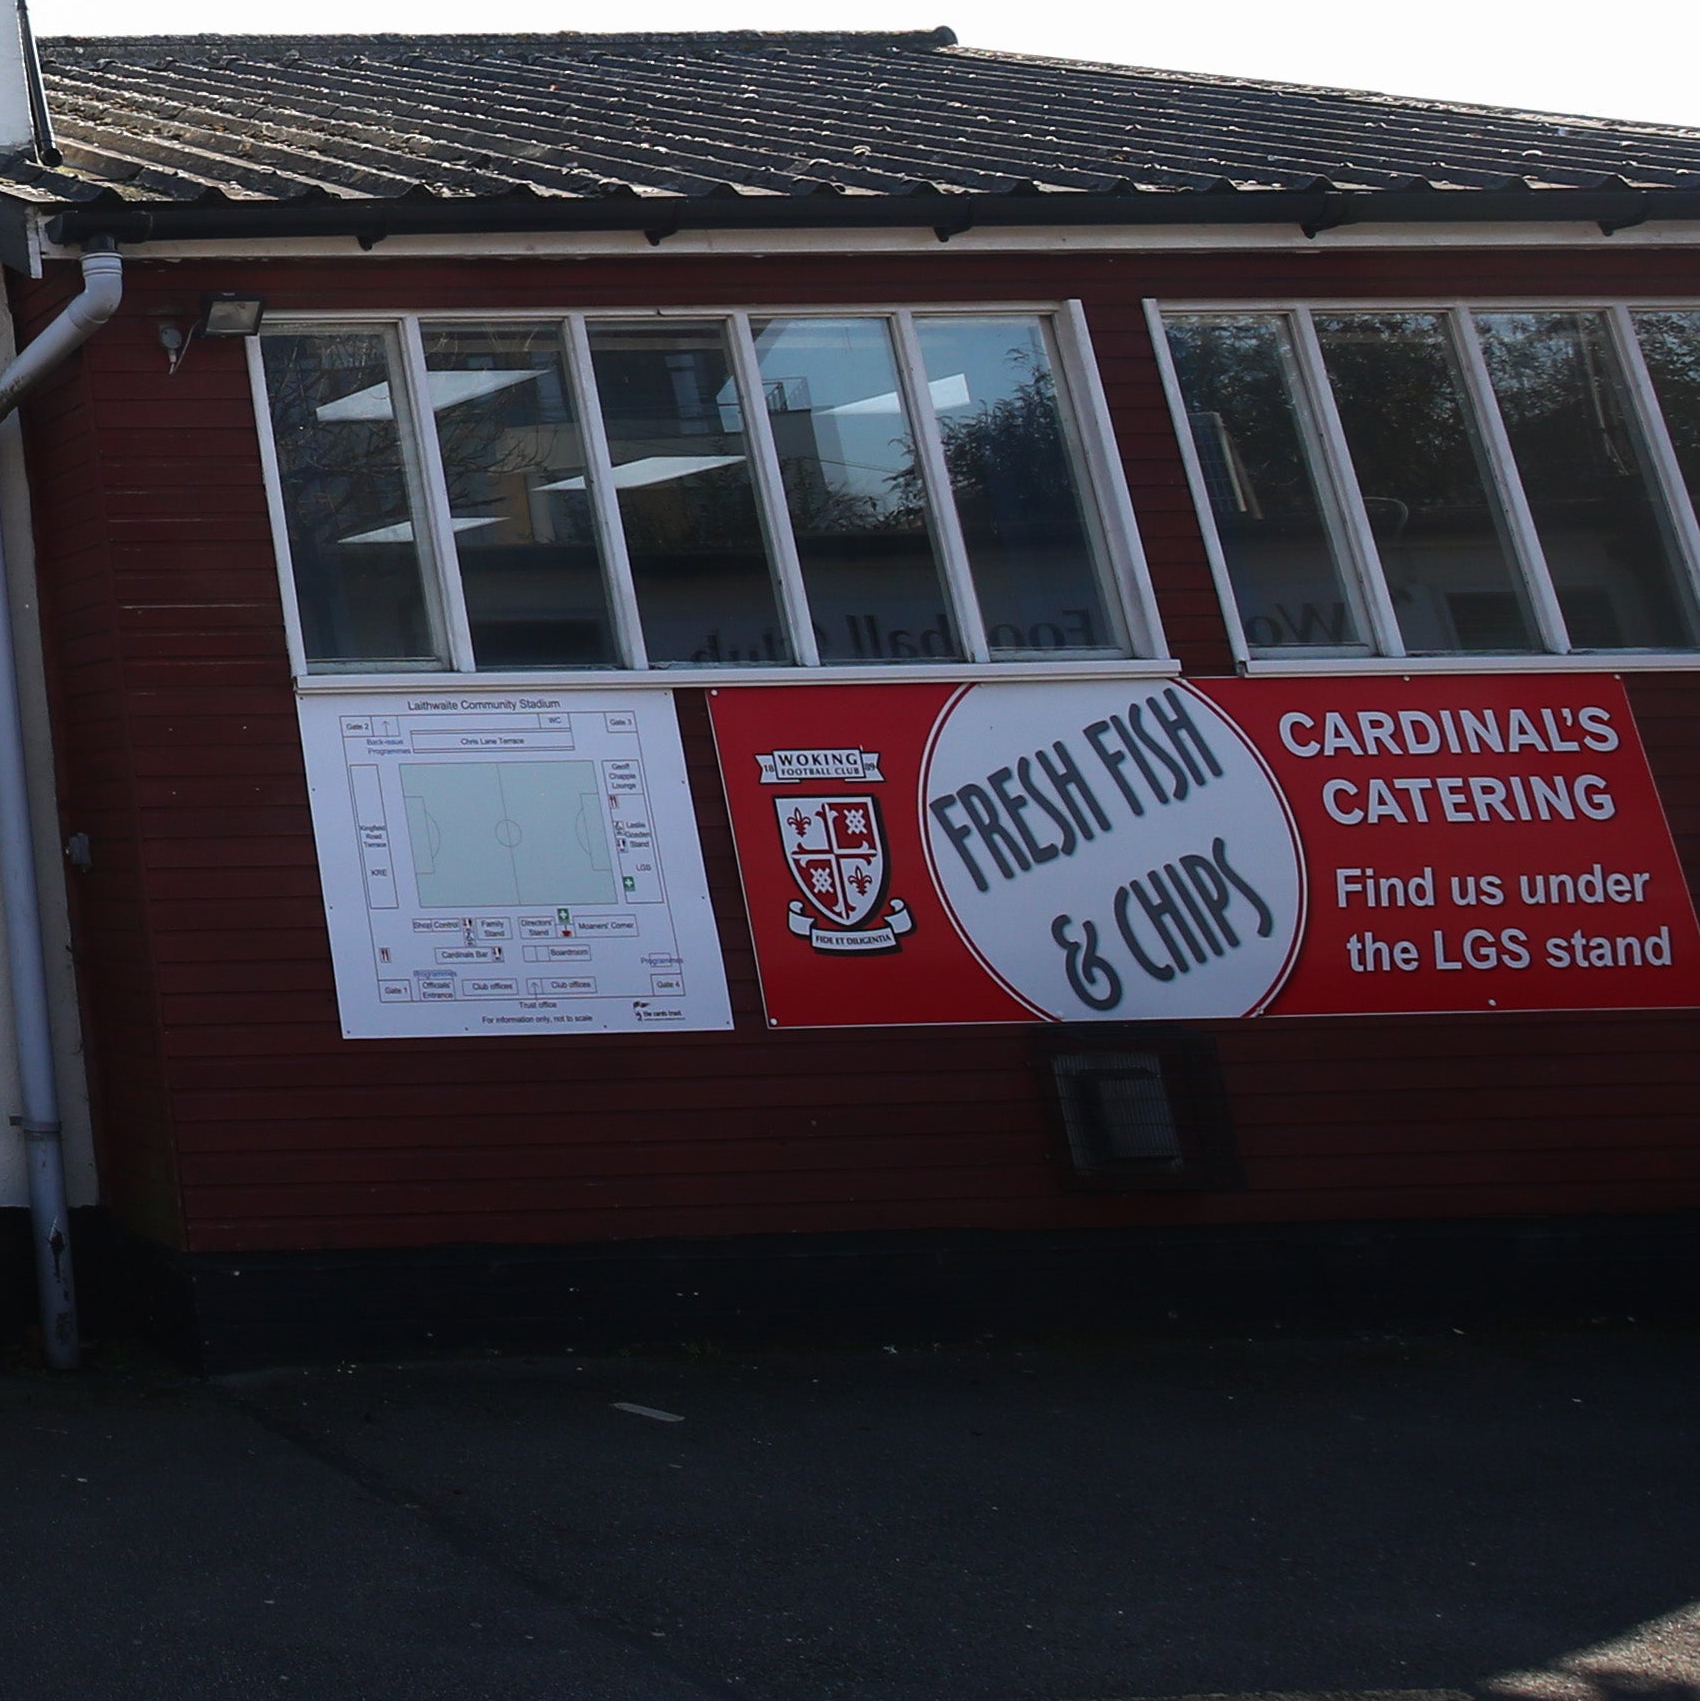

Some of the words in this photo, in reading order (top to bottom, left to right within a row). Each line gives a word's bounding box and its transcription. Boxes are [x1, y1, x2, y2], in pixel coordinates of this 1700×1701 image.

[407, 700, 458, 711] Laithwaite
[460, 700, 517, 712] Community
[519, 699, 561, 709] Stadium
[346, 723, 362, 731] Gate
[1279, 706, 1620, 758] CARDINAL'S
[498, 737, 525, 745] Terrace
[778, 753, 859, 767] WOKING
[781, 767, 832, 776] FOOTBALL
[835, 767, 860, 776] CLUB
[929, 740, 1112, 893] FRESH
[1082, 688, 1223, 817] FISH
[1322, 774, 1617, 825] CATERING
[1335, 867, 1435, 909] Find
[1450, 875, 1504, 907] us
[1519, 863, 1651, 906] under
[481, 920, 504, 929] Family
[1051, 914, 1123, 1012] &
[1113, 836, 1273, 982] CHIPS
[835, 936, 845, 946] ET
[1346, 931, 1420, 973] the
[1433, 928, 1531, 971] LGS
[1545, 925, 1673, 969] stand
[441, 951, 475, 959] Cardinals
[476, 950, 488, 958] Bar
[472, 983, 488, 991] Club
[551, 981, 567, 989] Club
[657, 981, 675, 989] Gate
[384, 987, 402, 995] Gate
